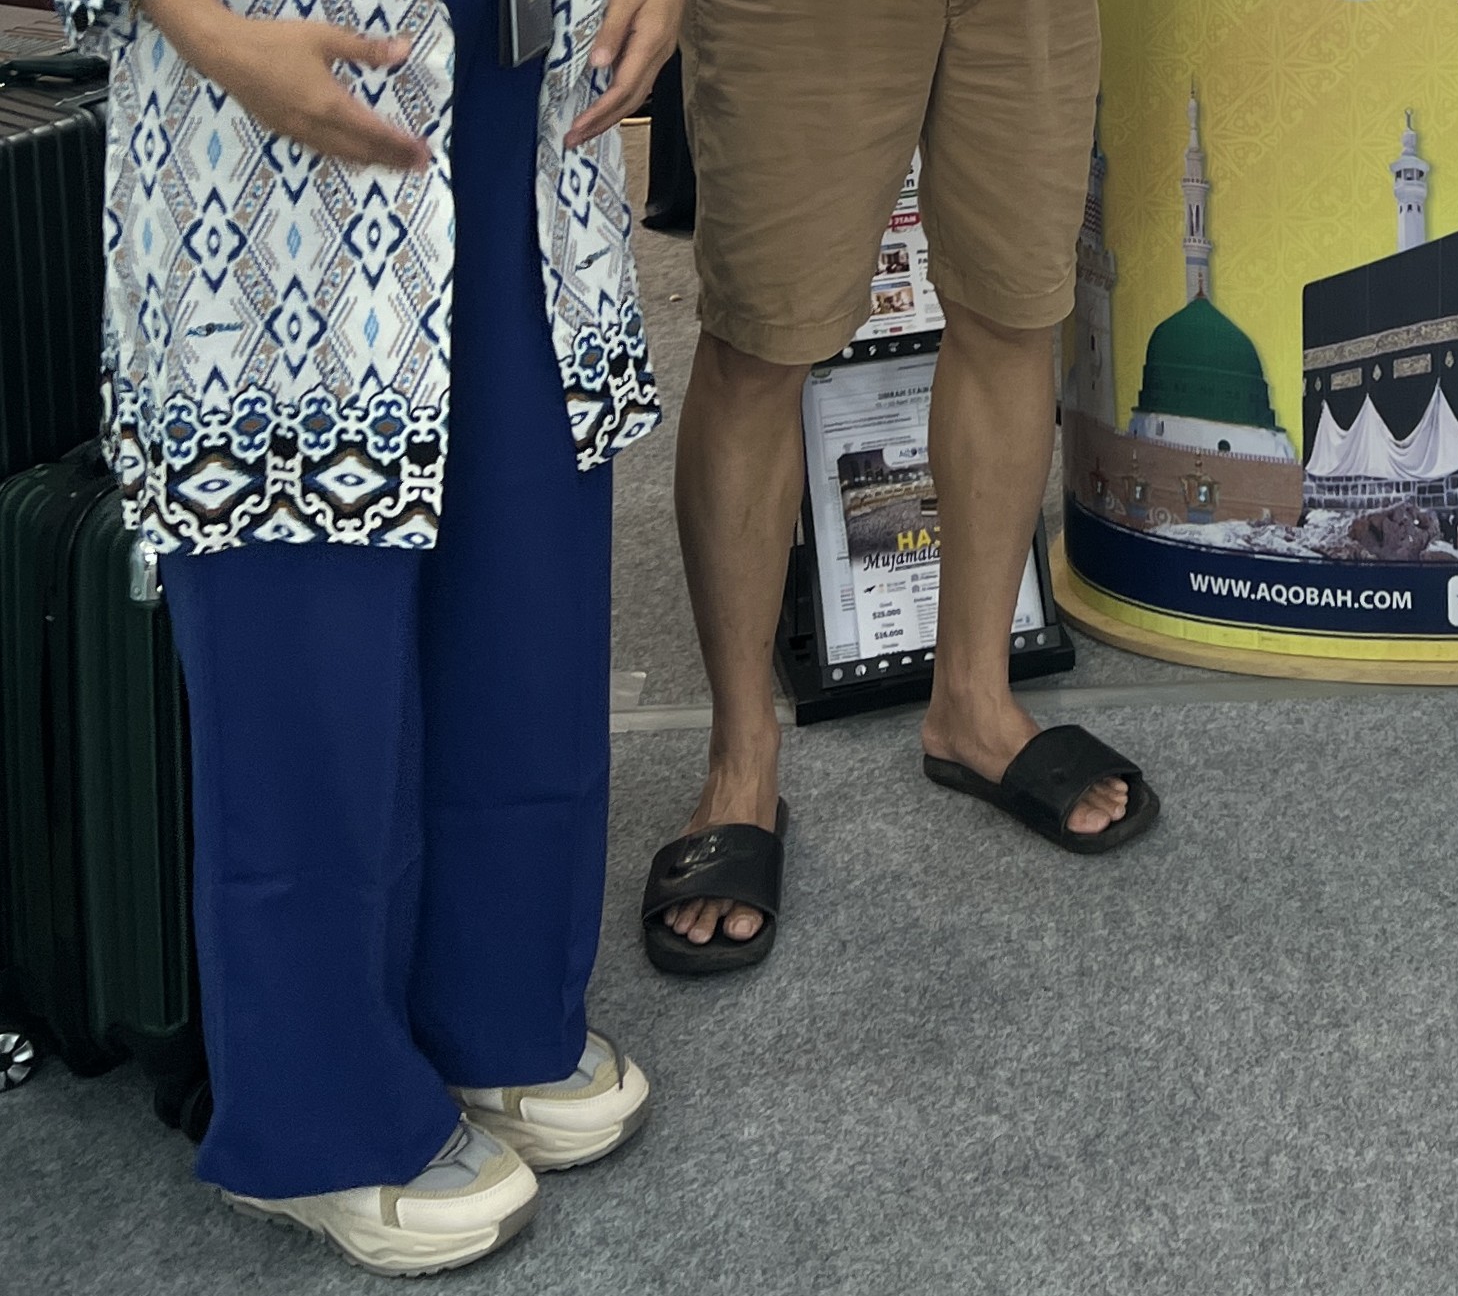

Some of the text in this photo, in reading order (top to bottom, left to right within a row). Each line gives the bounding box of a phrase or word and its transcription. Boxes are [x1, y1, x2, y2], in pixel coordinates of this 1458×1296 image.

[896, 525, 941, 552] HA
[862, 546, 941, 574] Mujamala
[1188, 571, 1413, 612] WWW.AQOBAH.COM
